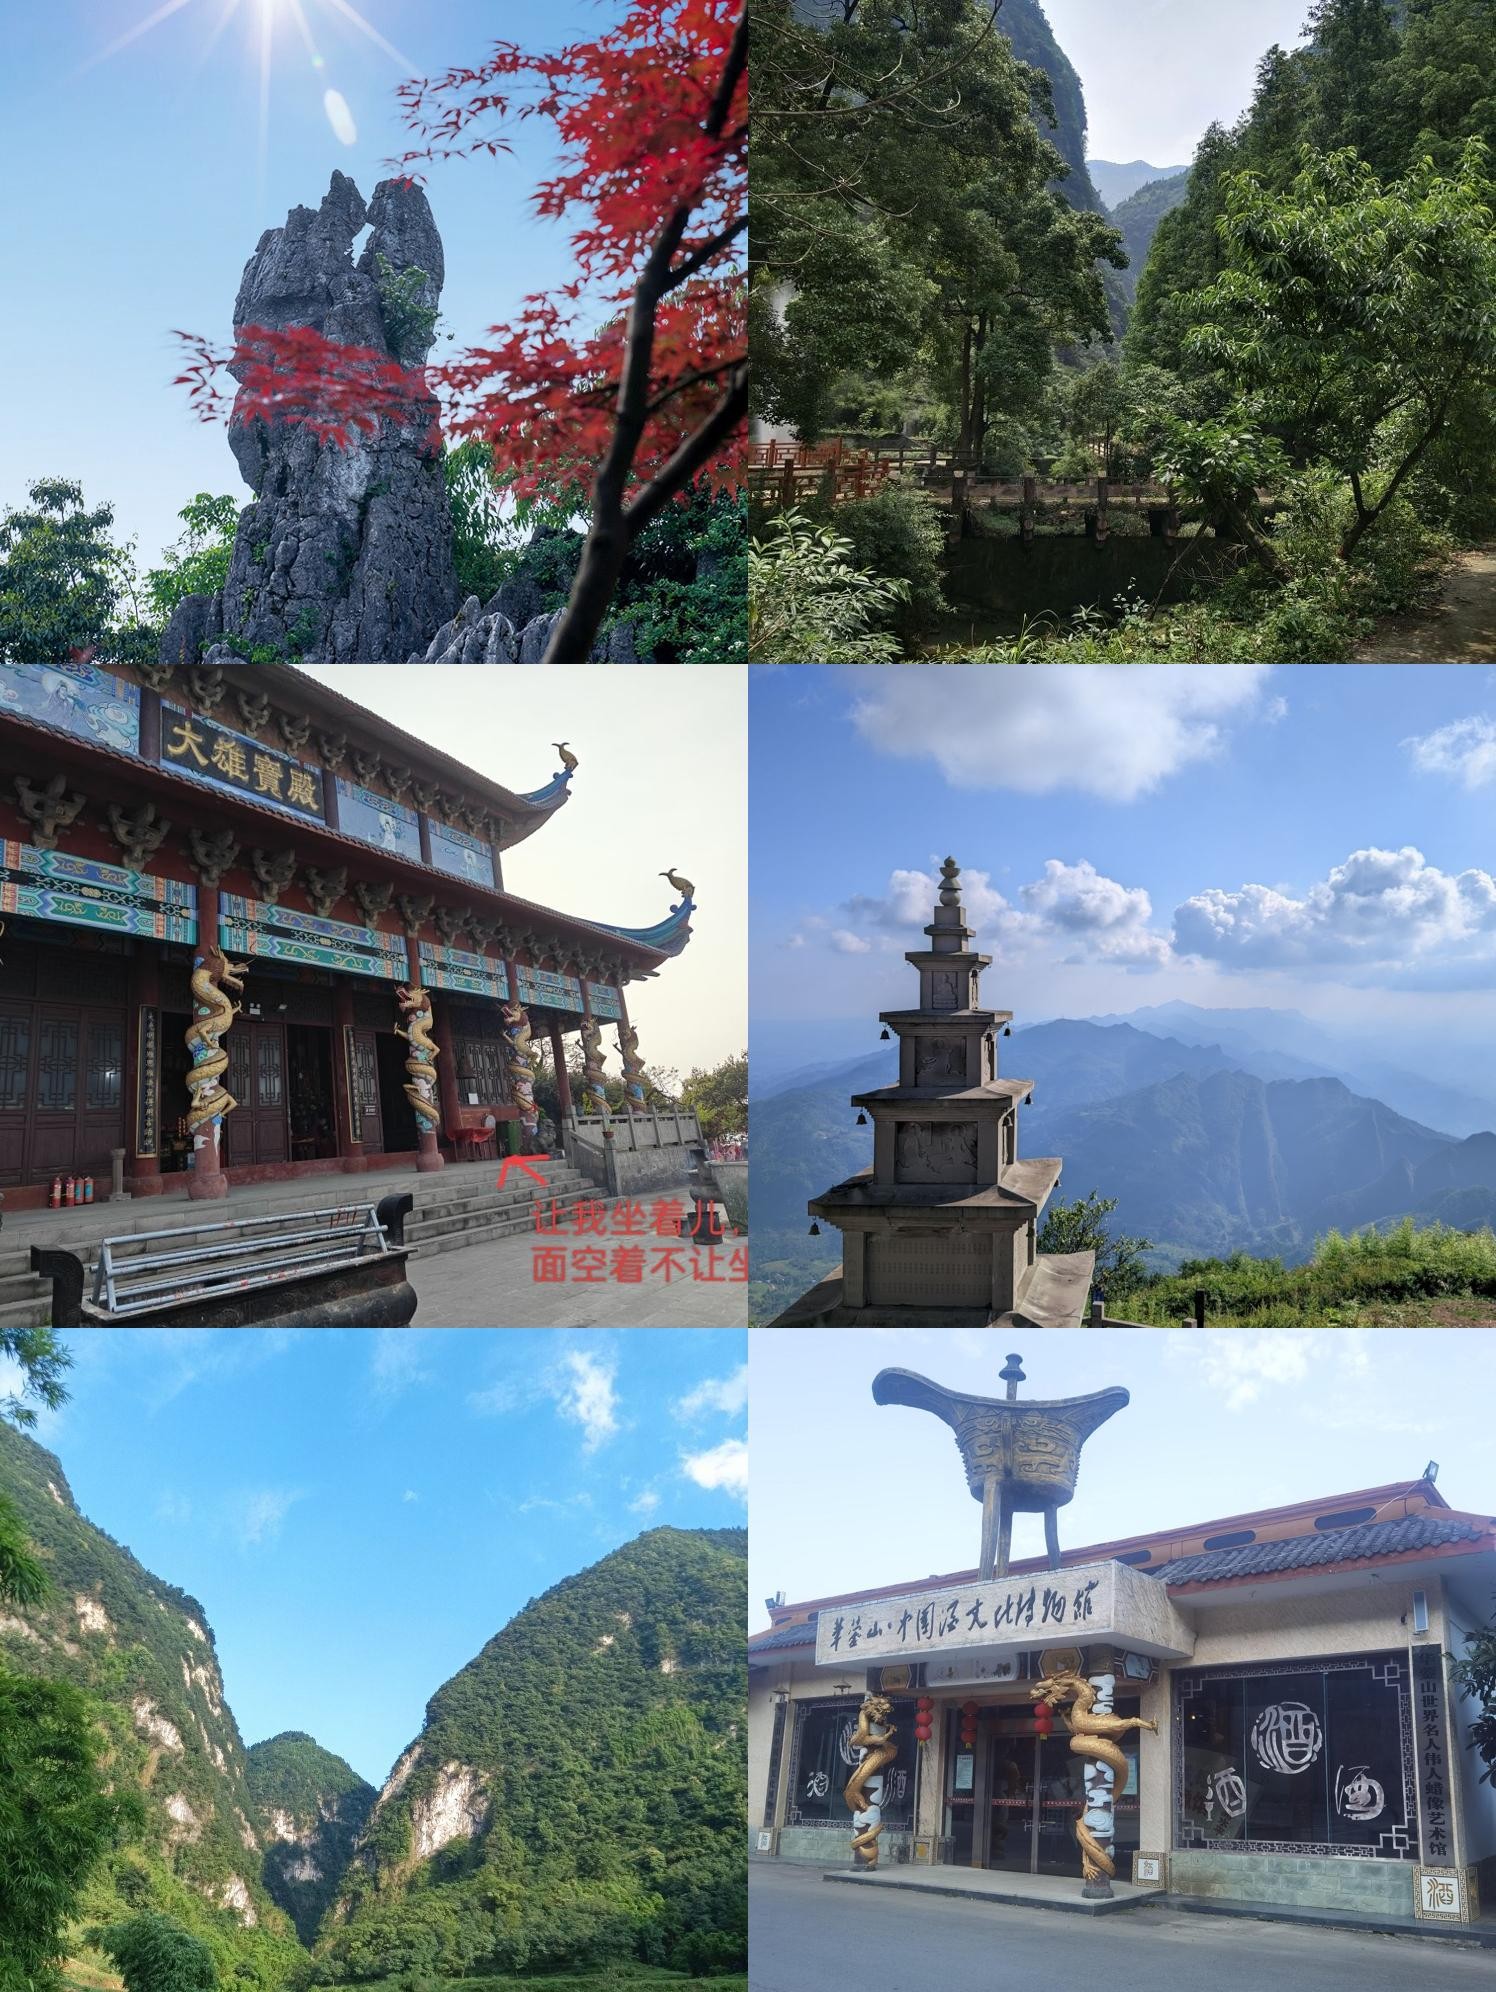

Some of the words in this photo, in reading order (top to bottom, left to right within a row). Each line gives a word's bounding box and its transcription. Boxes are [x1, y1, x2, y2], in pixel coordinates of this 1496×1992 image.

[167, 720, 320, 811] 大雄寶殿
[1427, 1878, 1454, 1910] 酒
